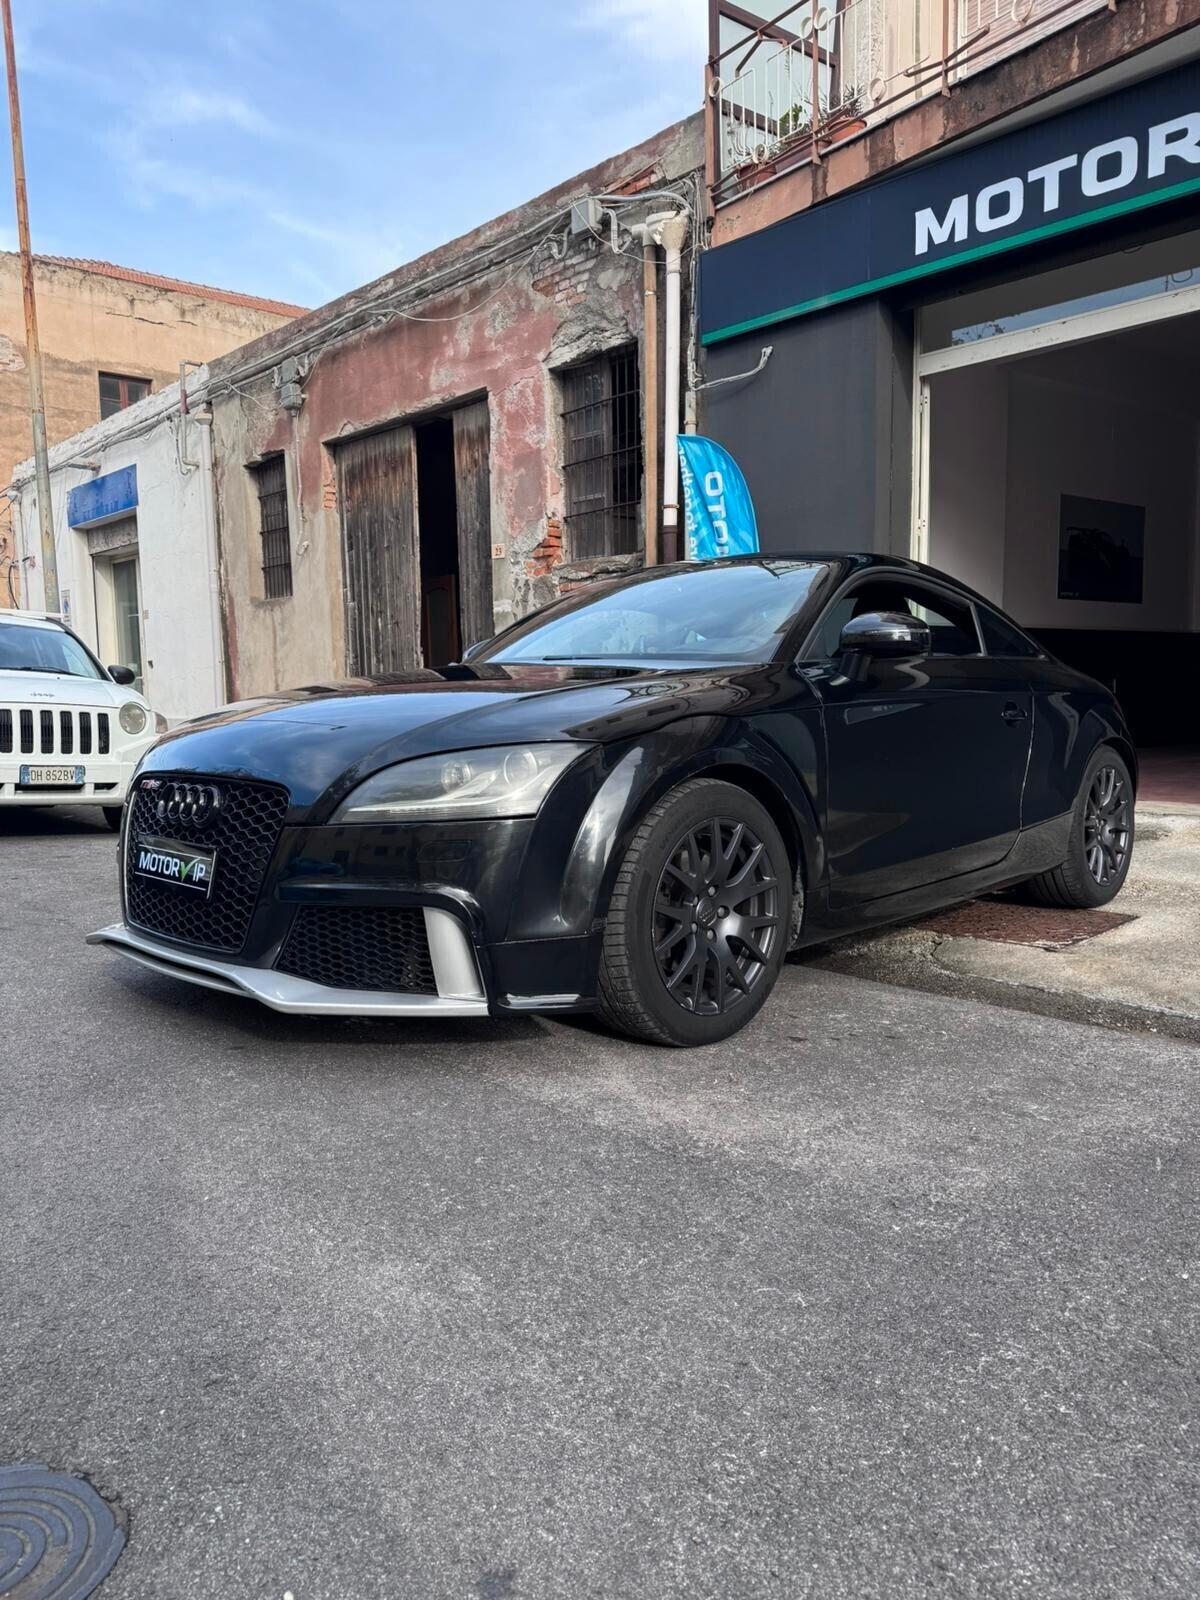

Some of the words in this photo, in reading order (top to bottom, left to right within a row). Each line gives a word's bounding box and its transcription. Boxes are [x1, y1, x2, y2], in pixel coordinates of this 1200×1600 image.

[915, 112, 1200, 255] MOTOR
[30, 769, 43, 781] DH
[45, 769, 75, 781] 852BV
